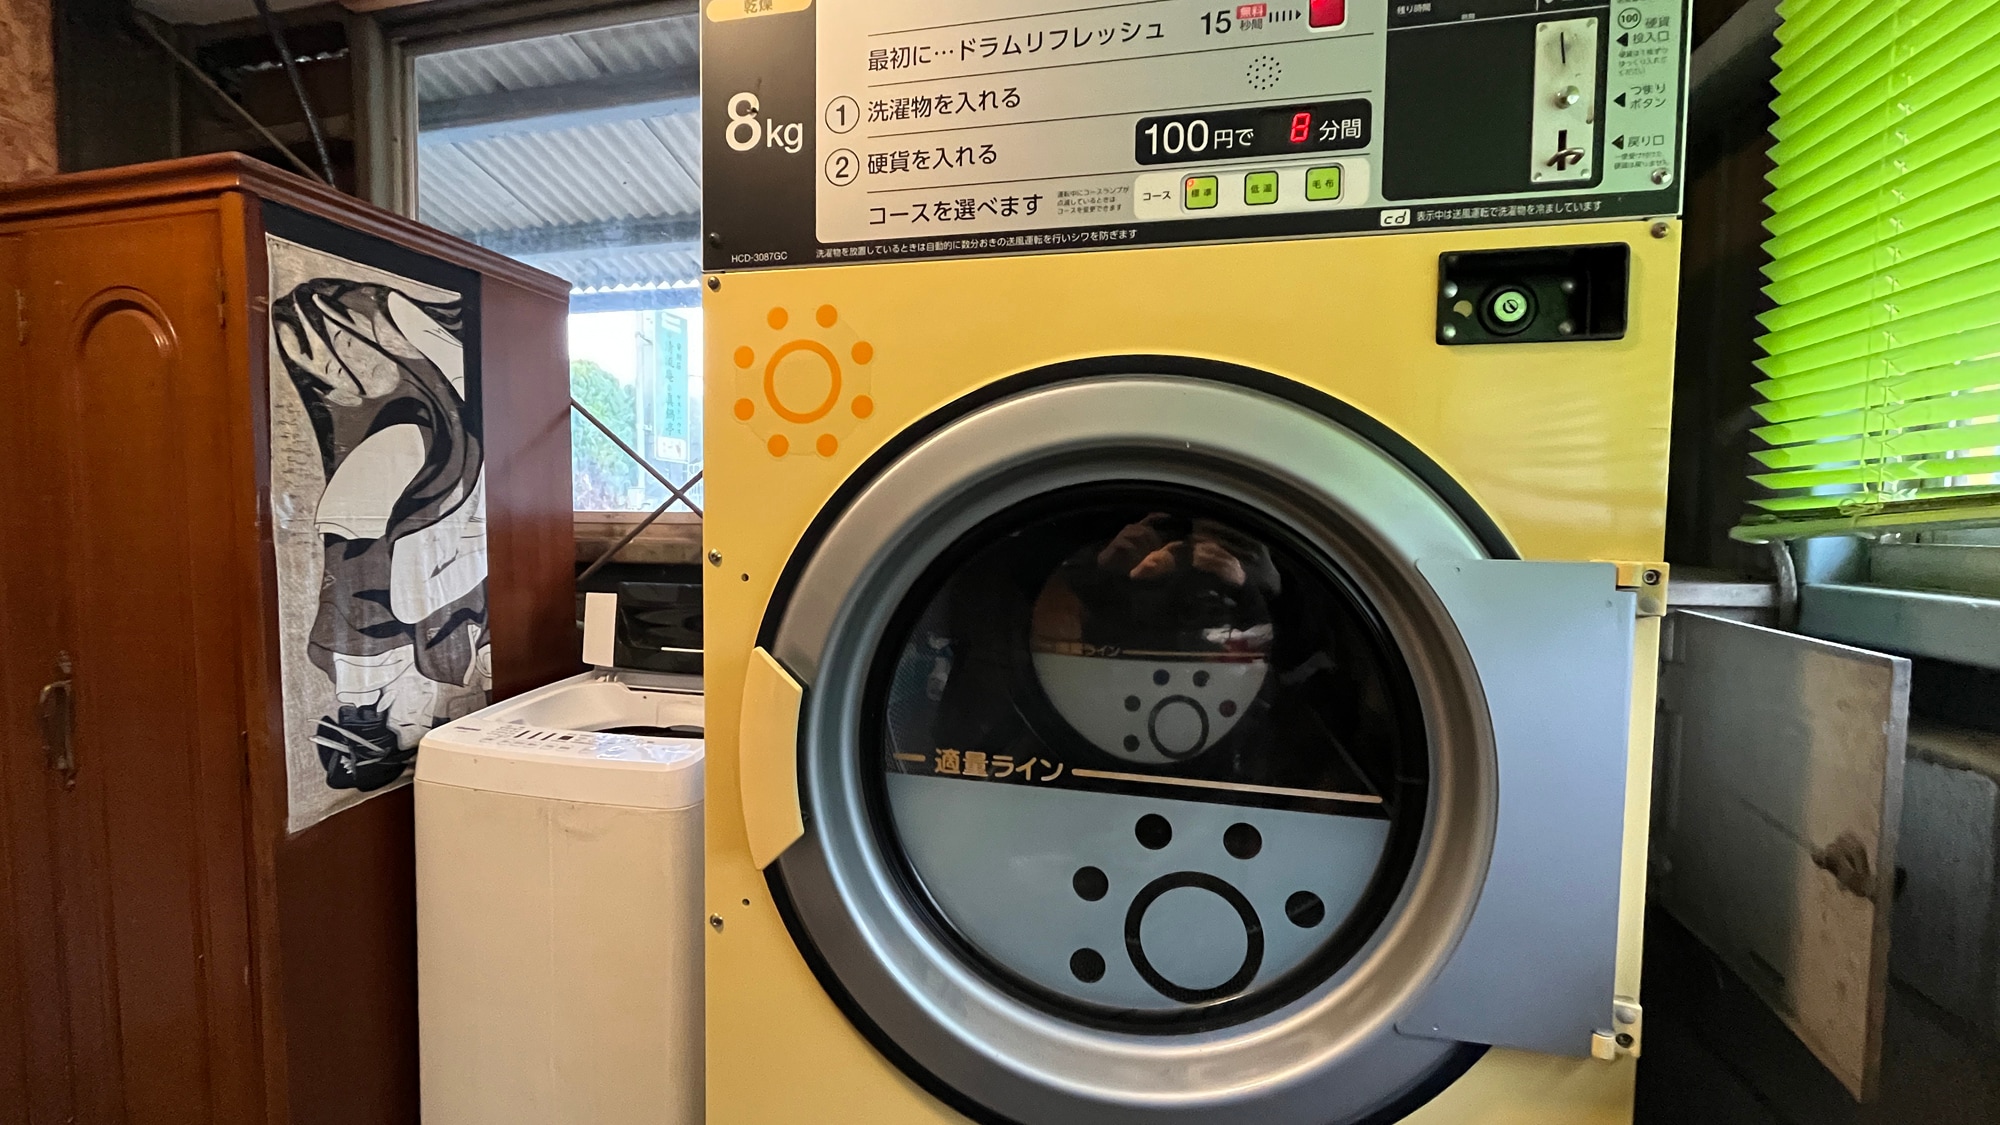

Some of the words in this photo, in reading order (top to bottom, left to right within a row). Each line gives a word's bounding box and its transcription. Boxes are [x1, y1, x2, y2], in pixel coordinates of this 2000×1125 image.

[1200, 9, 1232, 35] 15
[1240, 18, 1263, 31] 秒間
[1633, 31, 1670, 44] 投入口
[1630, 83, 1666, 96] つまり
[867, 87, 1022, 123] 洗濯物を入れる
[1630, 98, 1667, 110] ボタン
[1289, 112, 1312, 143] 8
[1319, 118, 1362, 142] 分間
[1627, 135, 1665, 148] 戻り口
[867, 144, 999, 175] 硬貨を入れる
[1312, 179, 1334, 190] 毛布
[1143, 190, 1171, 201] コース
[869, 194, 1043, 225] コースを選べます
[1384, 211, 1407, 224] cd
[731, 251, 788, 263] HCD-3087GC
[934, 747, 1064, 782] 適量ライン
